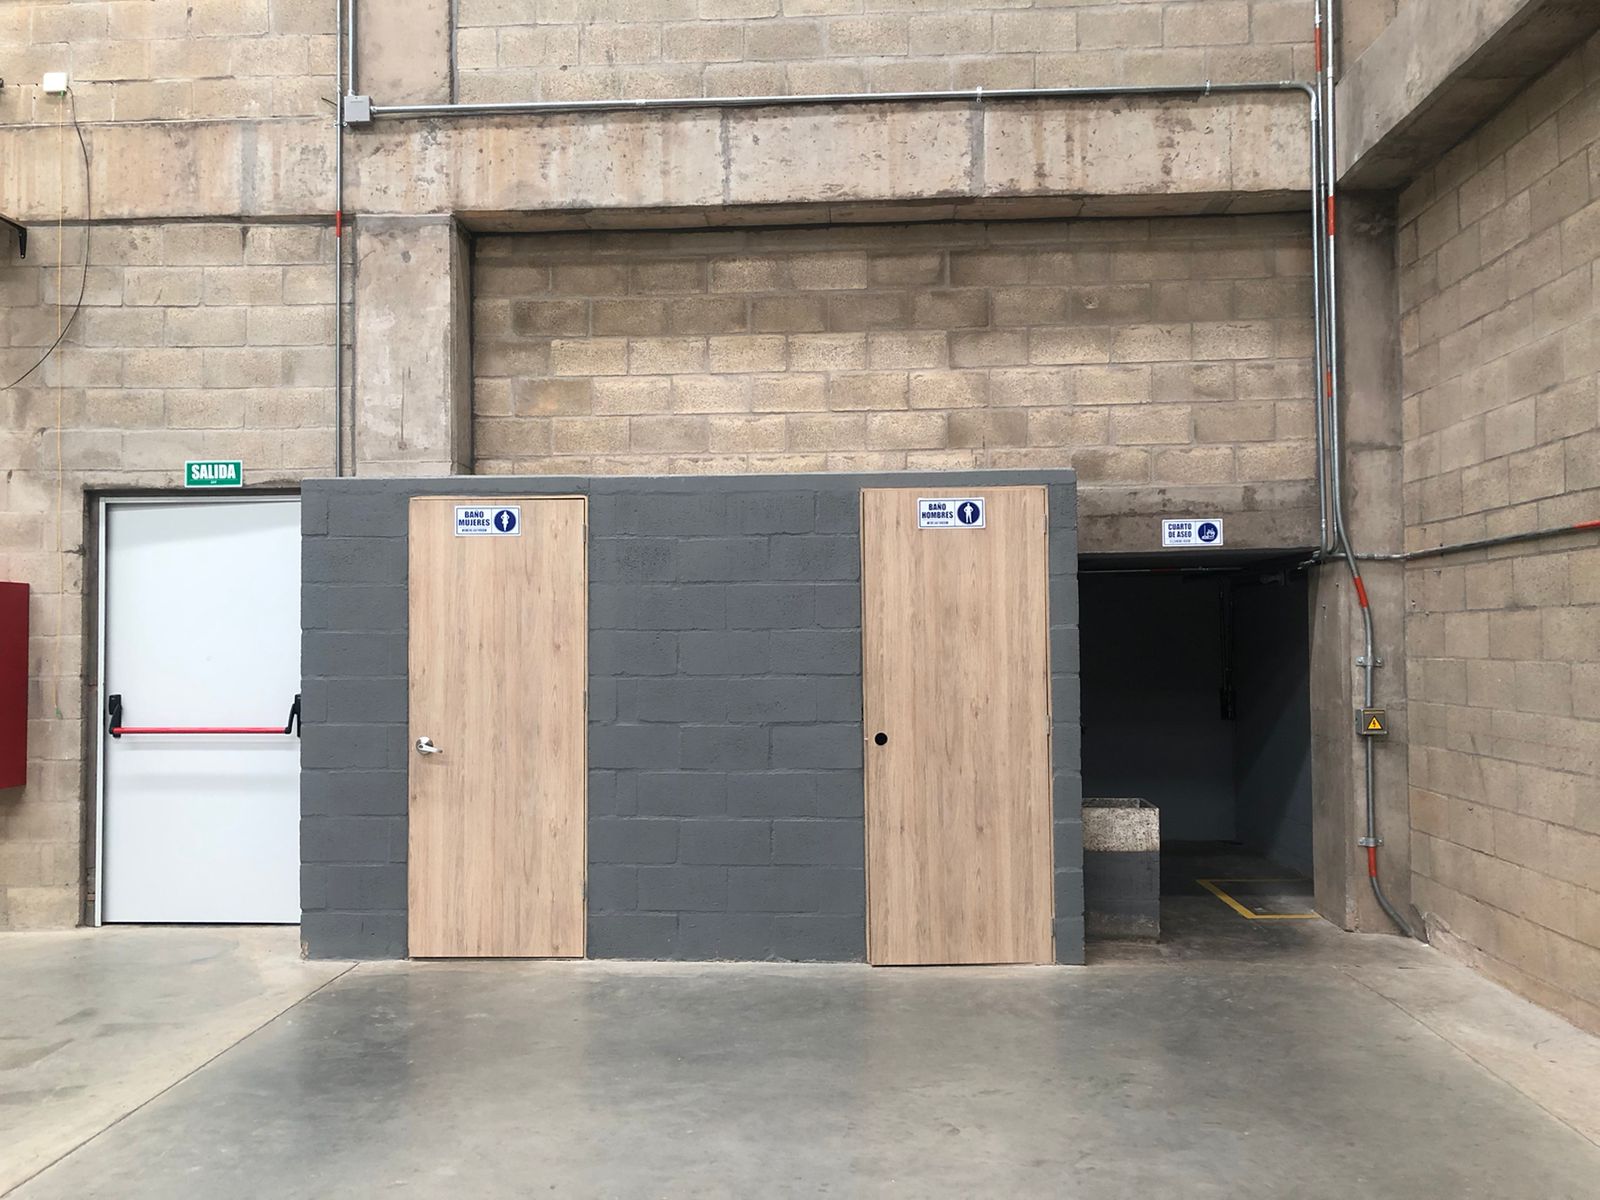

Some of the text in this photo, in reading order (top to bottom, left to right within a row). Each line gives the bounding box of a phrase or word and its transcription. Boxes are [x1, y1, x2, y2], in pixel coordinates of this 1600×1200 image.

[191, 464, 236, 480] SALIDA
[928, 502, 947, 511] BAÑO
[464, 509, 485, 518] BAÑO
[921, 511, 954, 519] HOMBRES
[458, 518, 491, 526] MUJERES
[1168, 523, 1192, 531] CUARTO
[1177, 530, 1192, 538] ASEO
